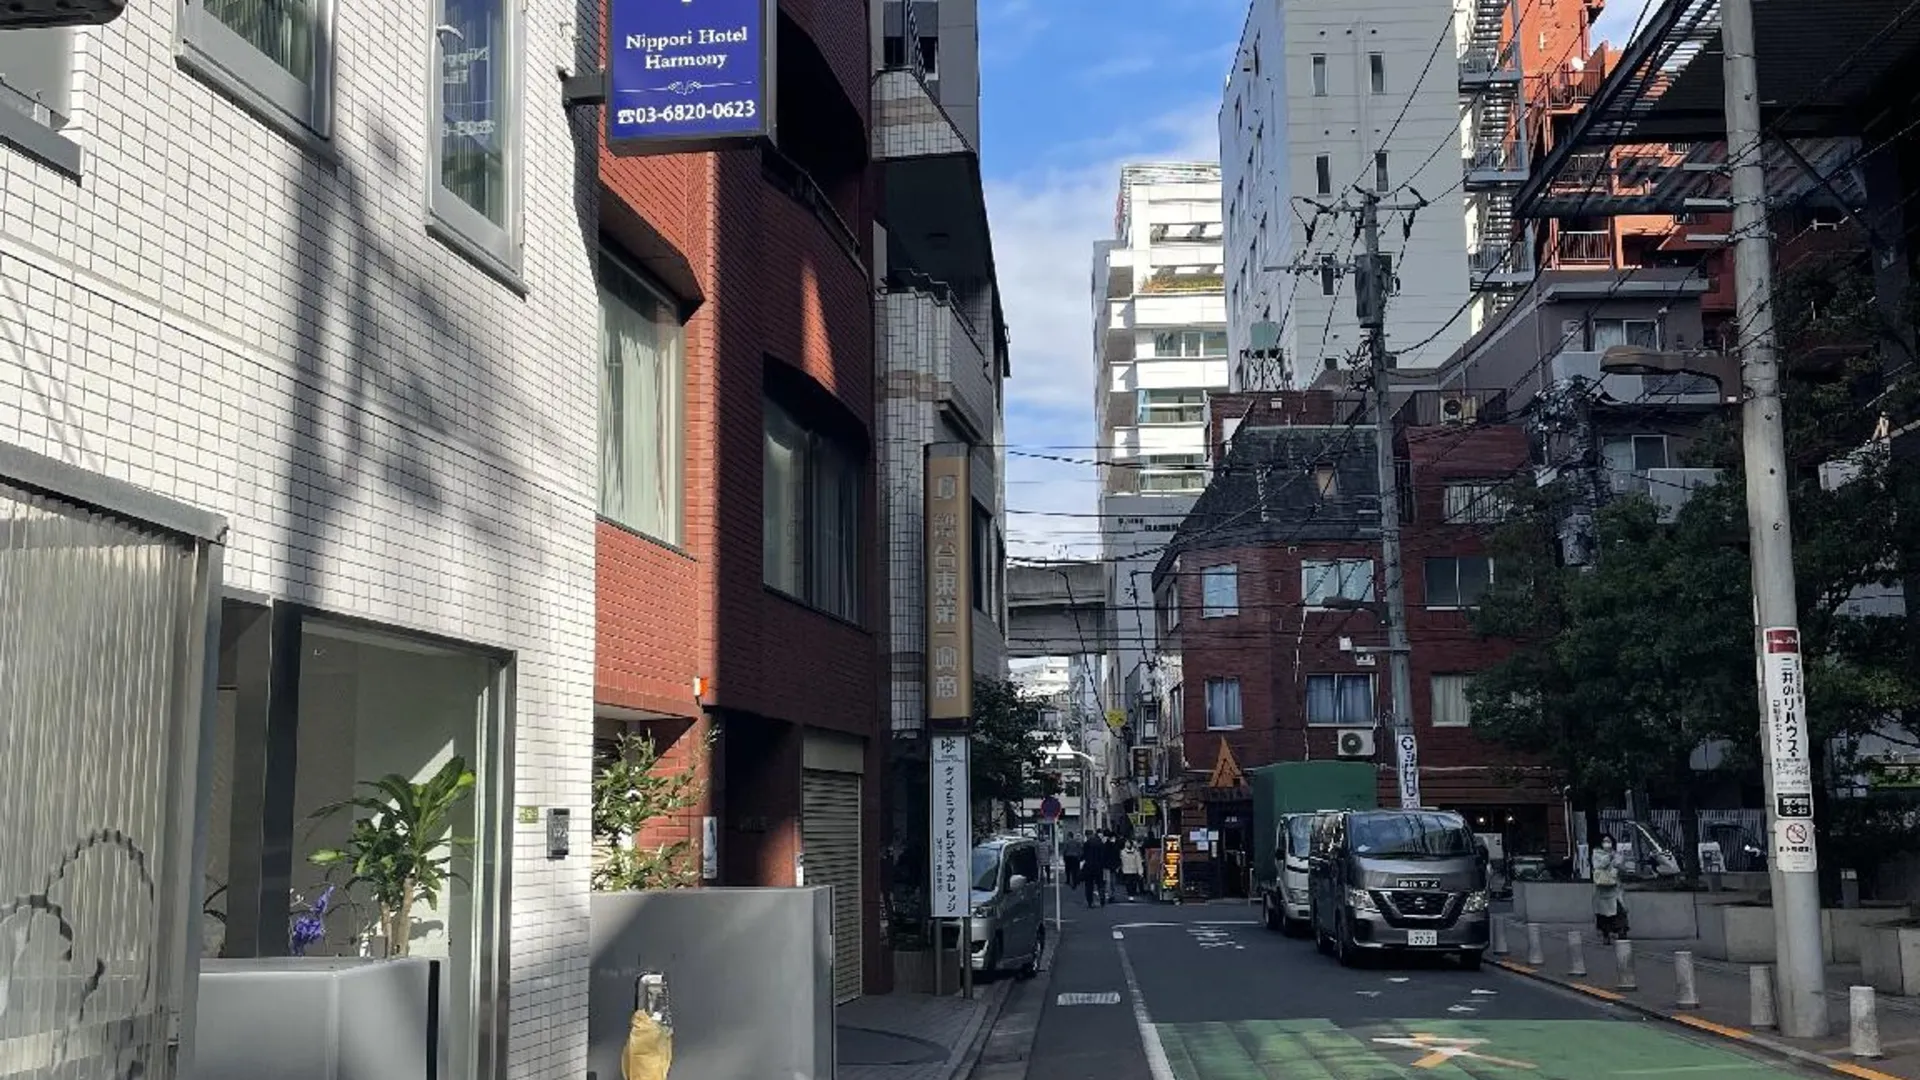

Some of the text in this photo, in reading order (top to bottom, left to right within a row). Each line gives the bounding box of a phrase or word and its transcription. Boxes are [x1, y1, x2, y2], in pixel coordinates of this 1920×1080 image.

[625, 26, 748, 52] Nippori Hotel
[645, 54, 728, 69] Harmony
[635, 99, 756, 123] 03-6820-0623
